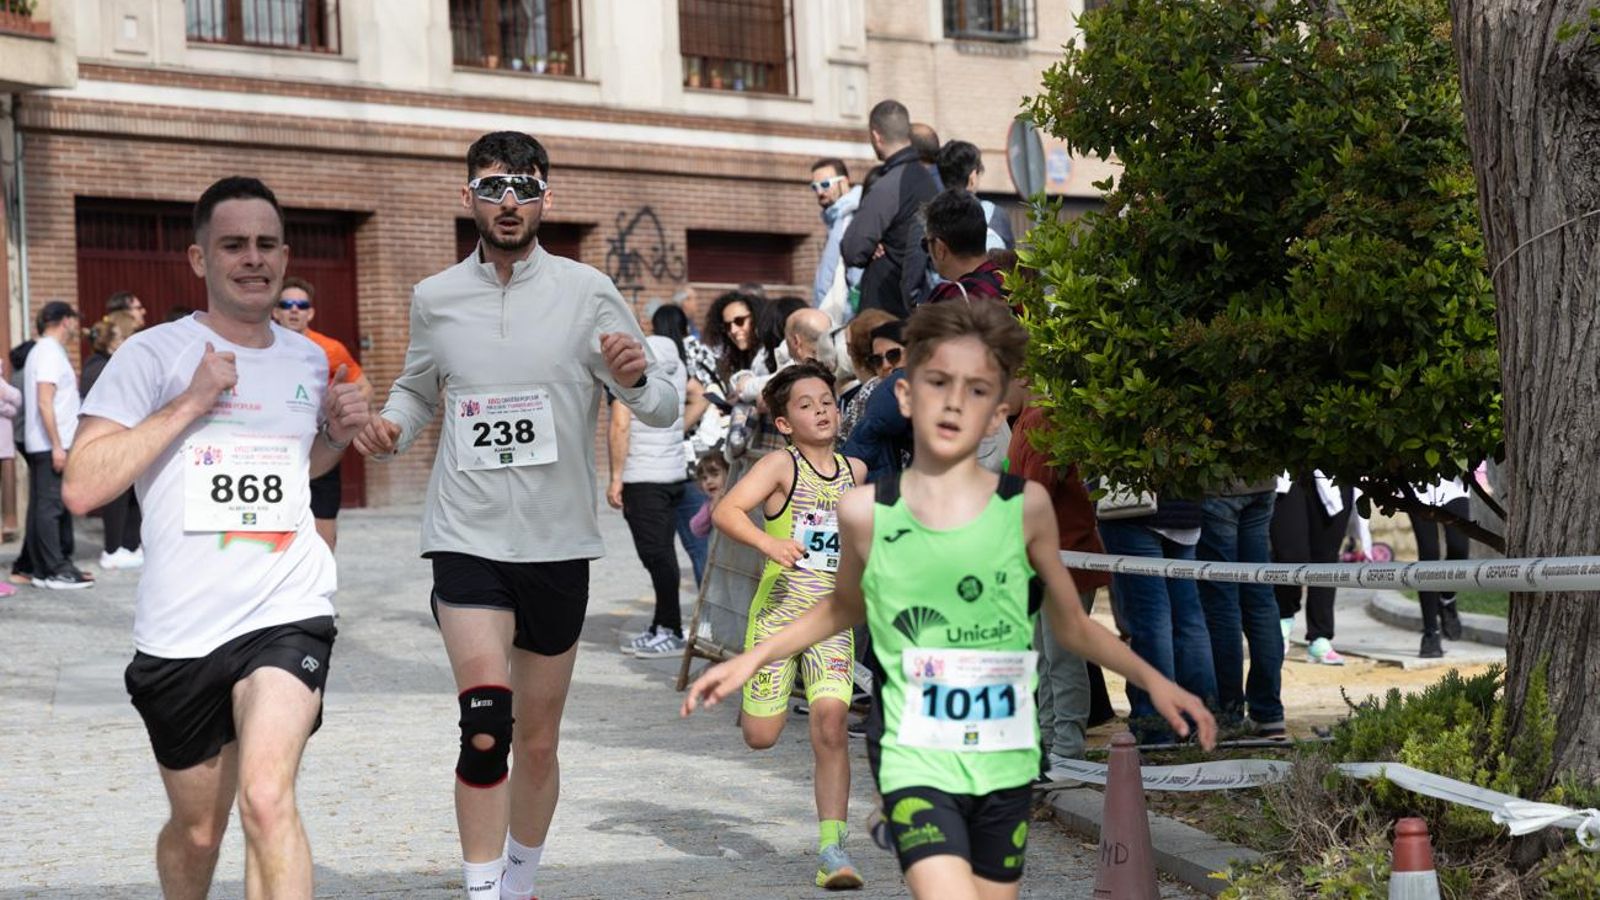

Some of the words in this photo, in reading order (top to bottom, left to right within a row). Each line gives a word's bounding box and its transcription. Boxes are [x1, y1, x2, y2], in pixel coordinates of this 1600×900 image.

[473, 418, 535, 447] 238
[211, 474, 283, 503] 868
[810, 532, 840, 552] 54
[1486, 565, 1520, 578] DEPORTES
[946, 620, 1012, 643] Unicaja
[922, 684, 1015, 720] 1011
